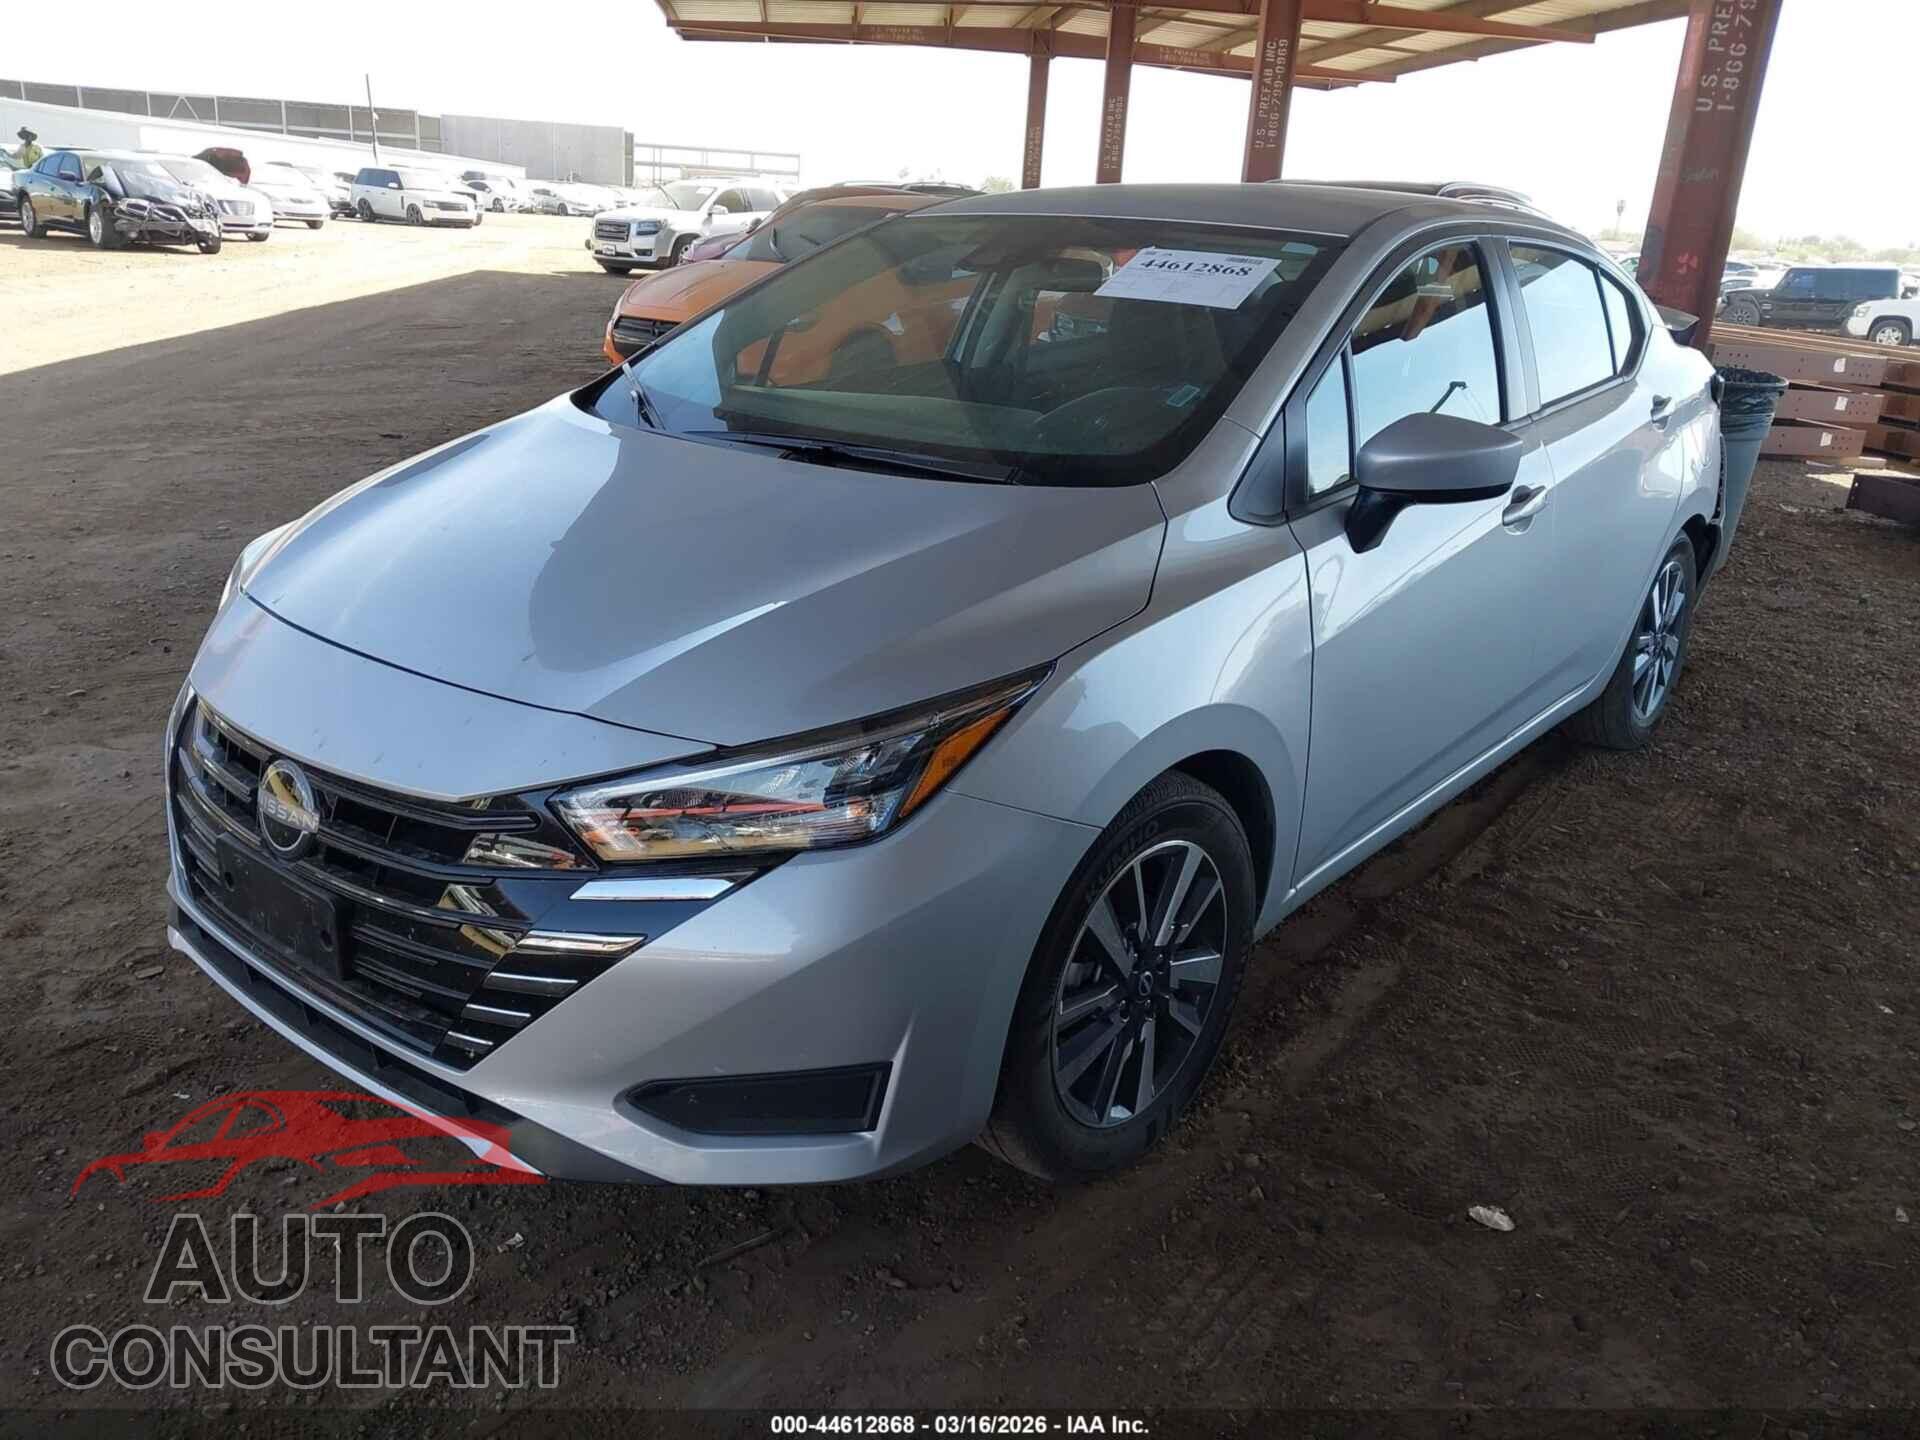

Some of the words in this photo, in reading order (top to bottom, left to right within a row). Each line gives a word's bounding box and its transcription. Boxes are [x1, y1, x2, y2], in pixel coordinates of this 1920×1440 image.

[1258, 68, 1273, 118] PREFAB
[1696, 67, 1721, 112] U.S.
[1141, 258, 1252, 277] 44612868
